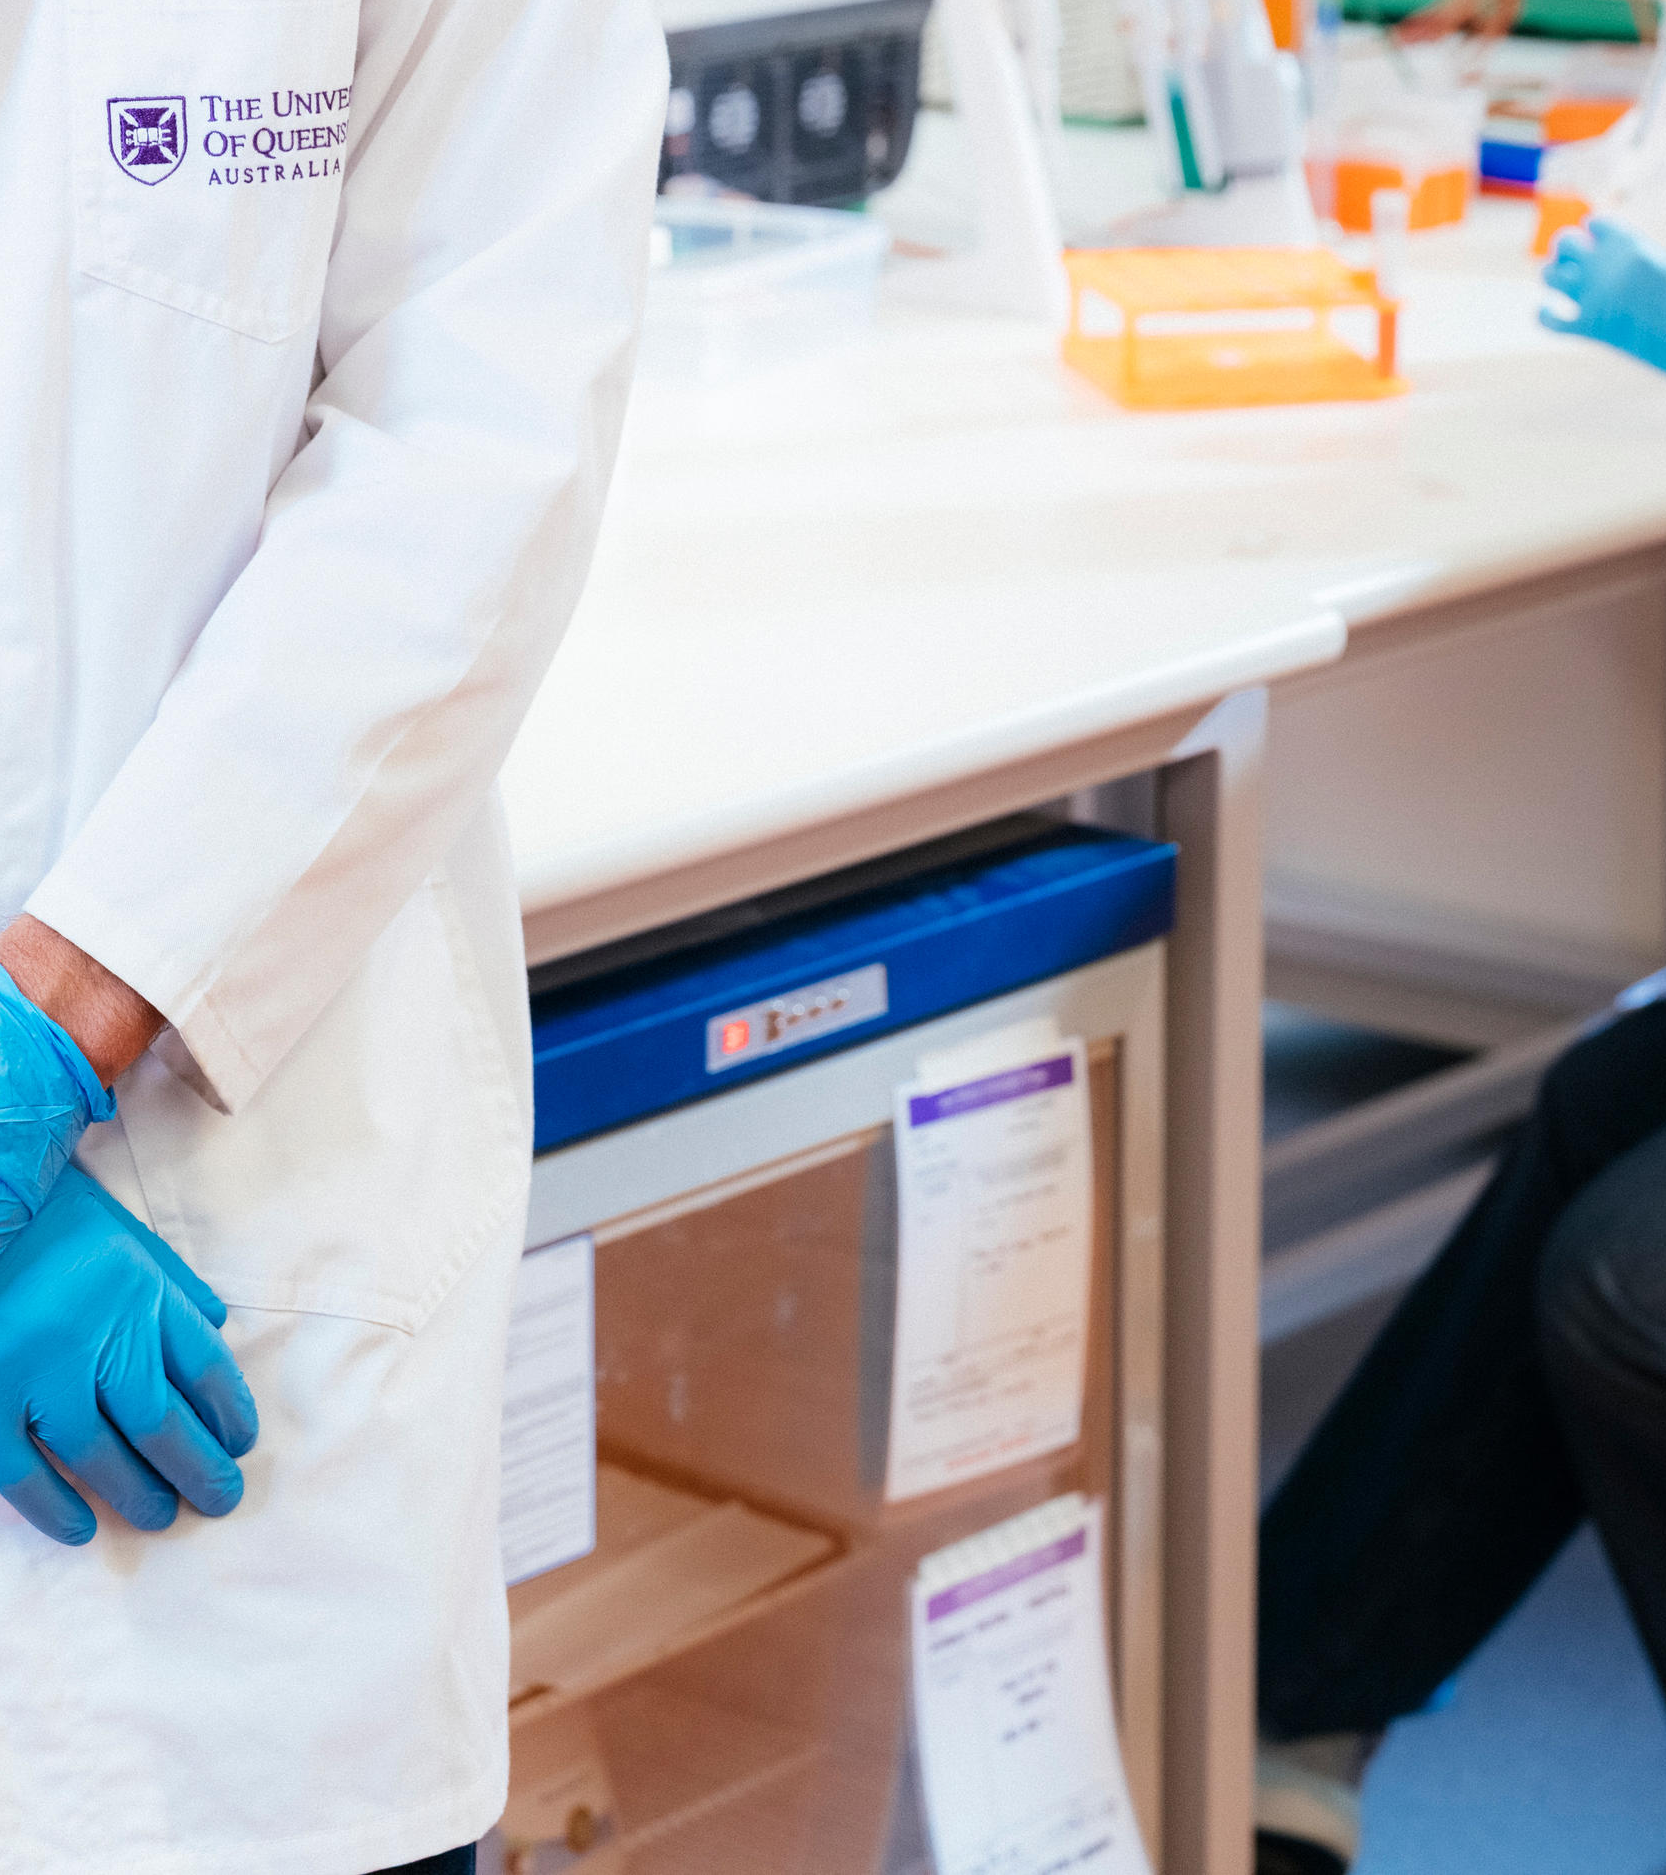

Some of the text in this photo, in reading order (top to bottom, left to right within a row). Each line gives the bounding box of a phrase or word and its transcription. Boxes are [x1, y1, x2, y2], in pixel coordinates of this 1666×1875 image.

[200, 86, 352, 122] THE UNIVE
[203, 122, 349, 159] OF QUEENS
[208, 157, 341, 186] AUSTRALIA
